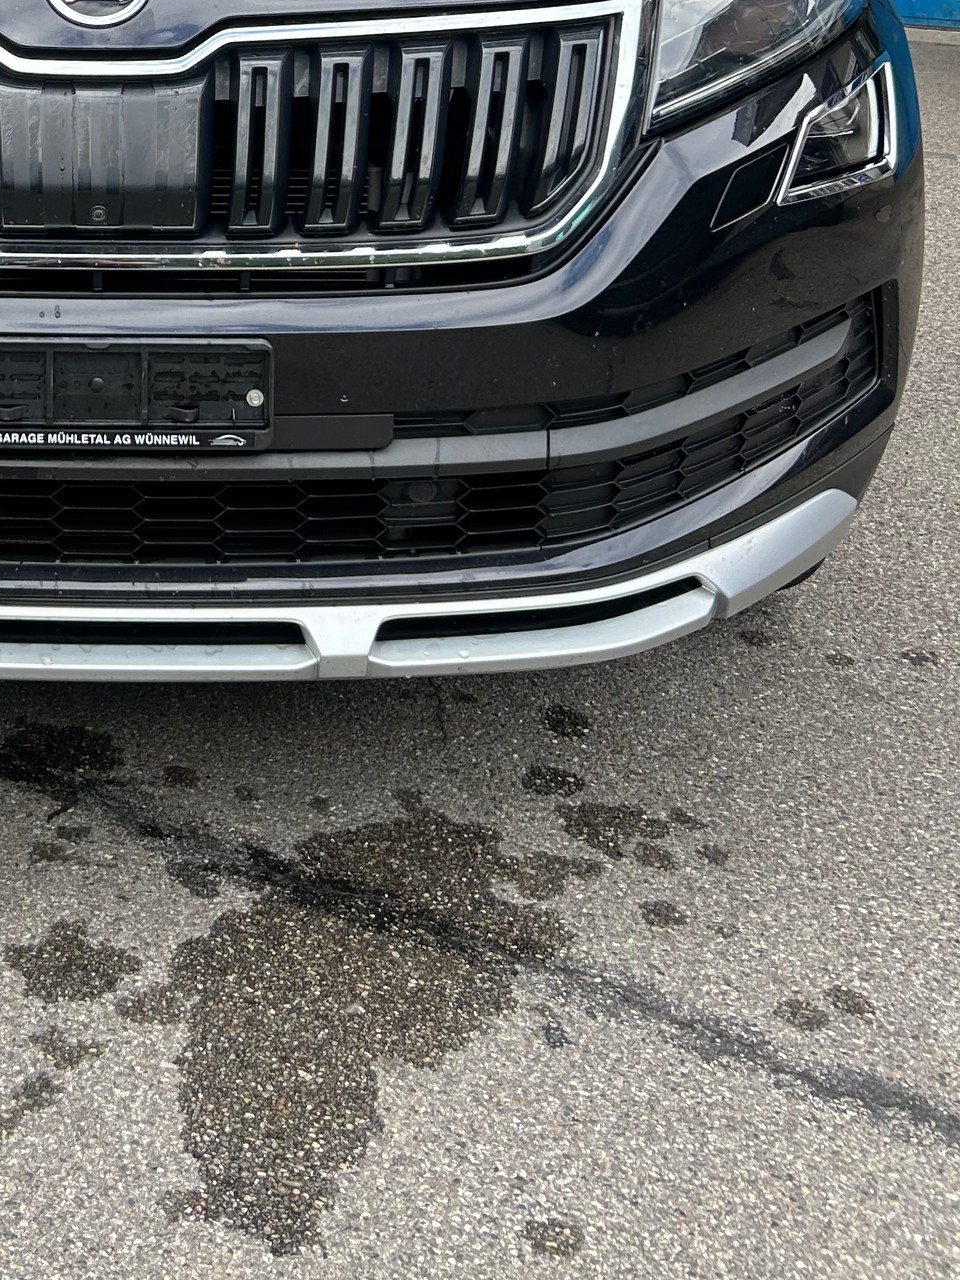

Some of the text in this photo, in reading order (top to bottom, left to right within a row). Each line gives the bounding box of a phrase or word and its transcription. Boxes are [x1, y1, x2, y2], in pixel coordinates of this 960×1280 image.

[47, 431, 112, 445] MÜHLETAL
[113, 433, 132, 445] AG
[134, 432, 200, 446] WÜNNEWIL
